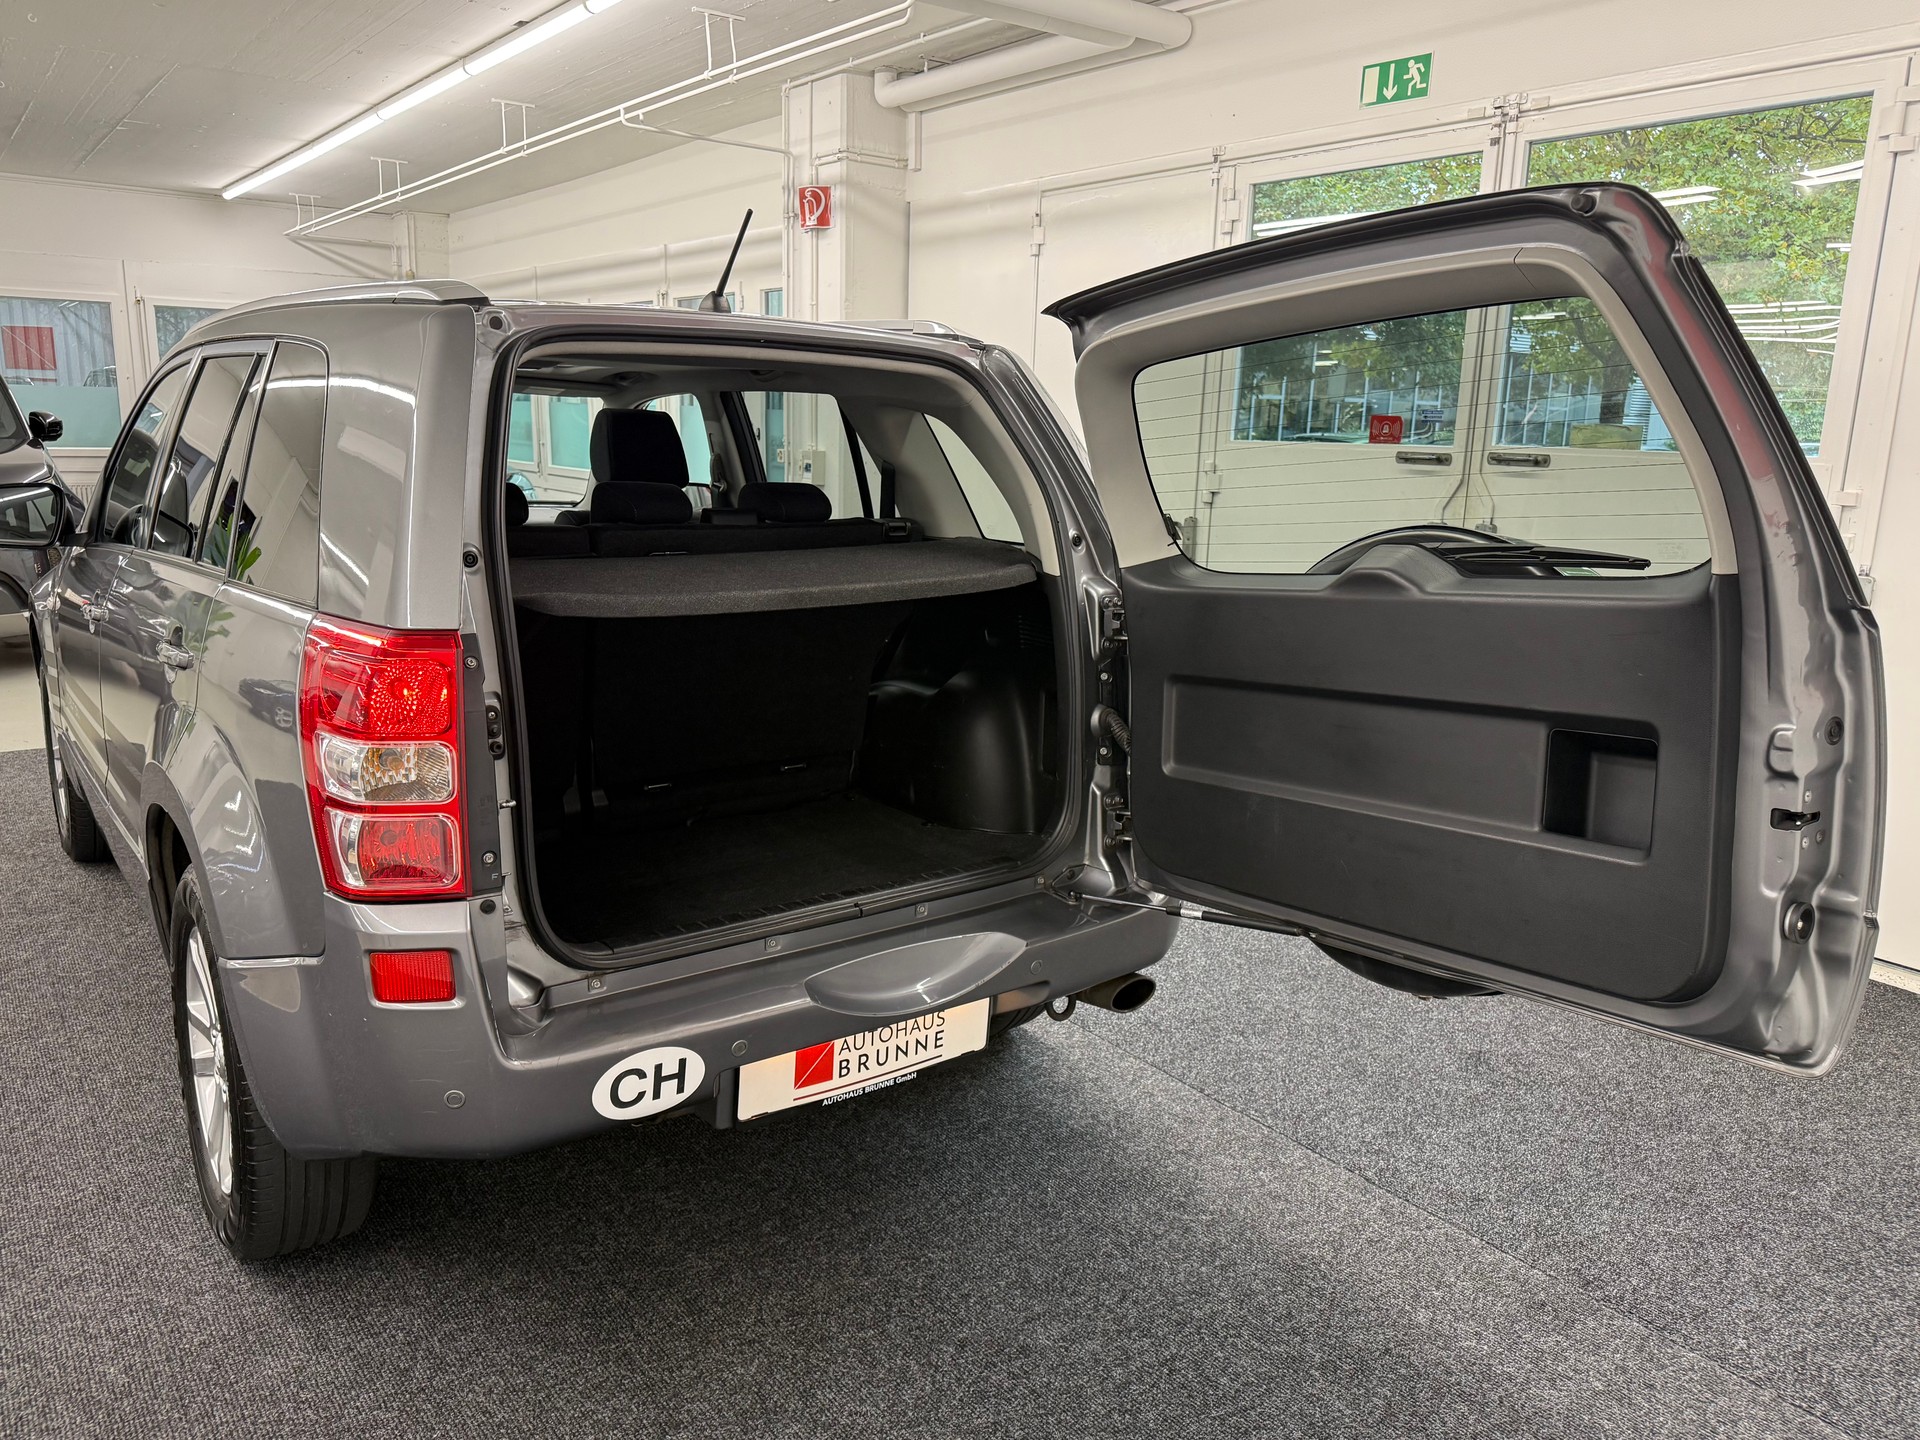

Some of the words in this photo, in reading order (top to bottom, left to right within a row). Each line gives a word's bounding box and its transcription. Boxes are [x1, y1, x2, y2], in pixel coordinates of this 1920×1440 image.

[838, 1030, 944, 1078] BRUNNE
[839, 1011, 945, 1055] AUTOHAUS
[610, 1057, 687, 1108] CH
[822, 1088, 863, 1106] AUTOHAUS
[865, 1079, 894, 1093] BRUNNE
[896, 1072, 917, 1083] GmbH
